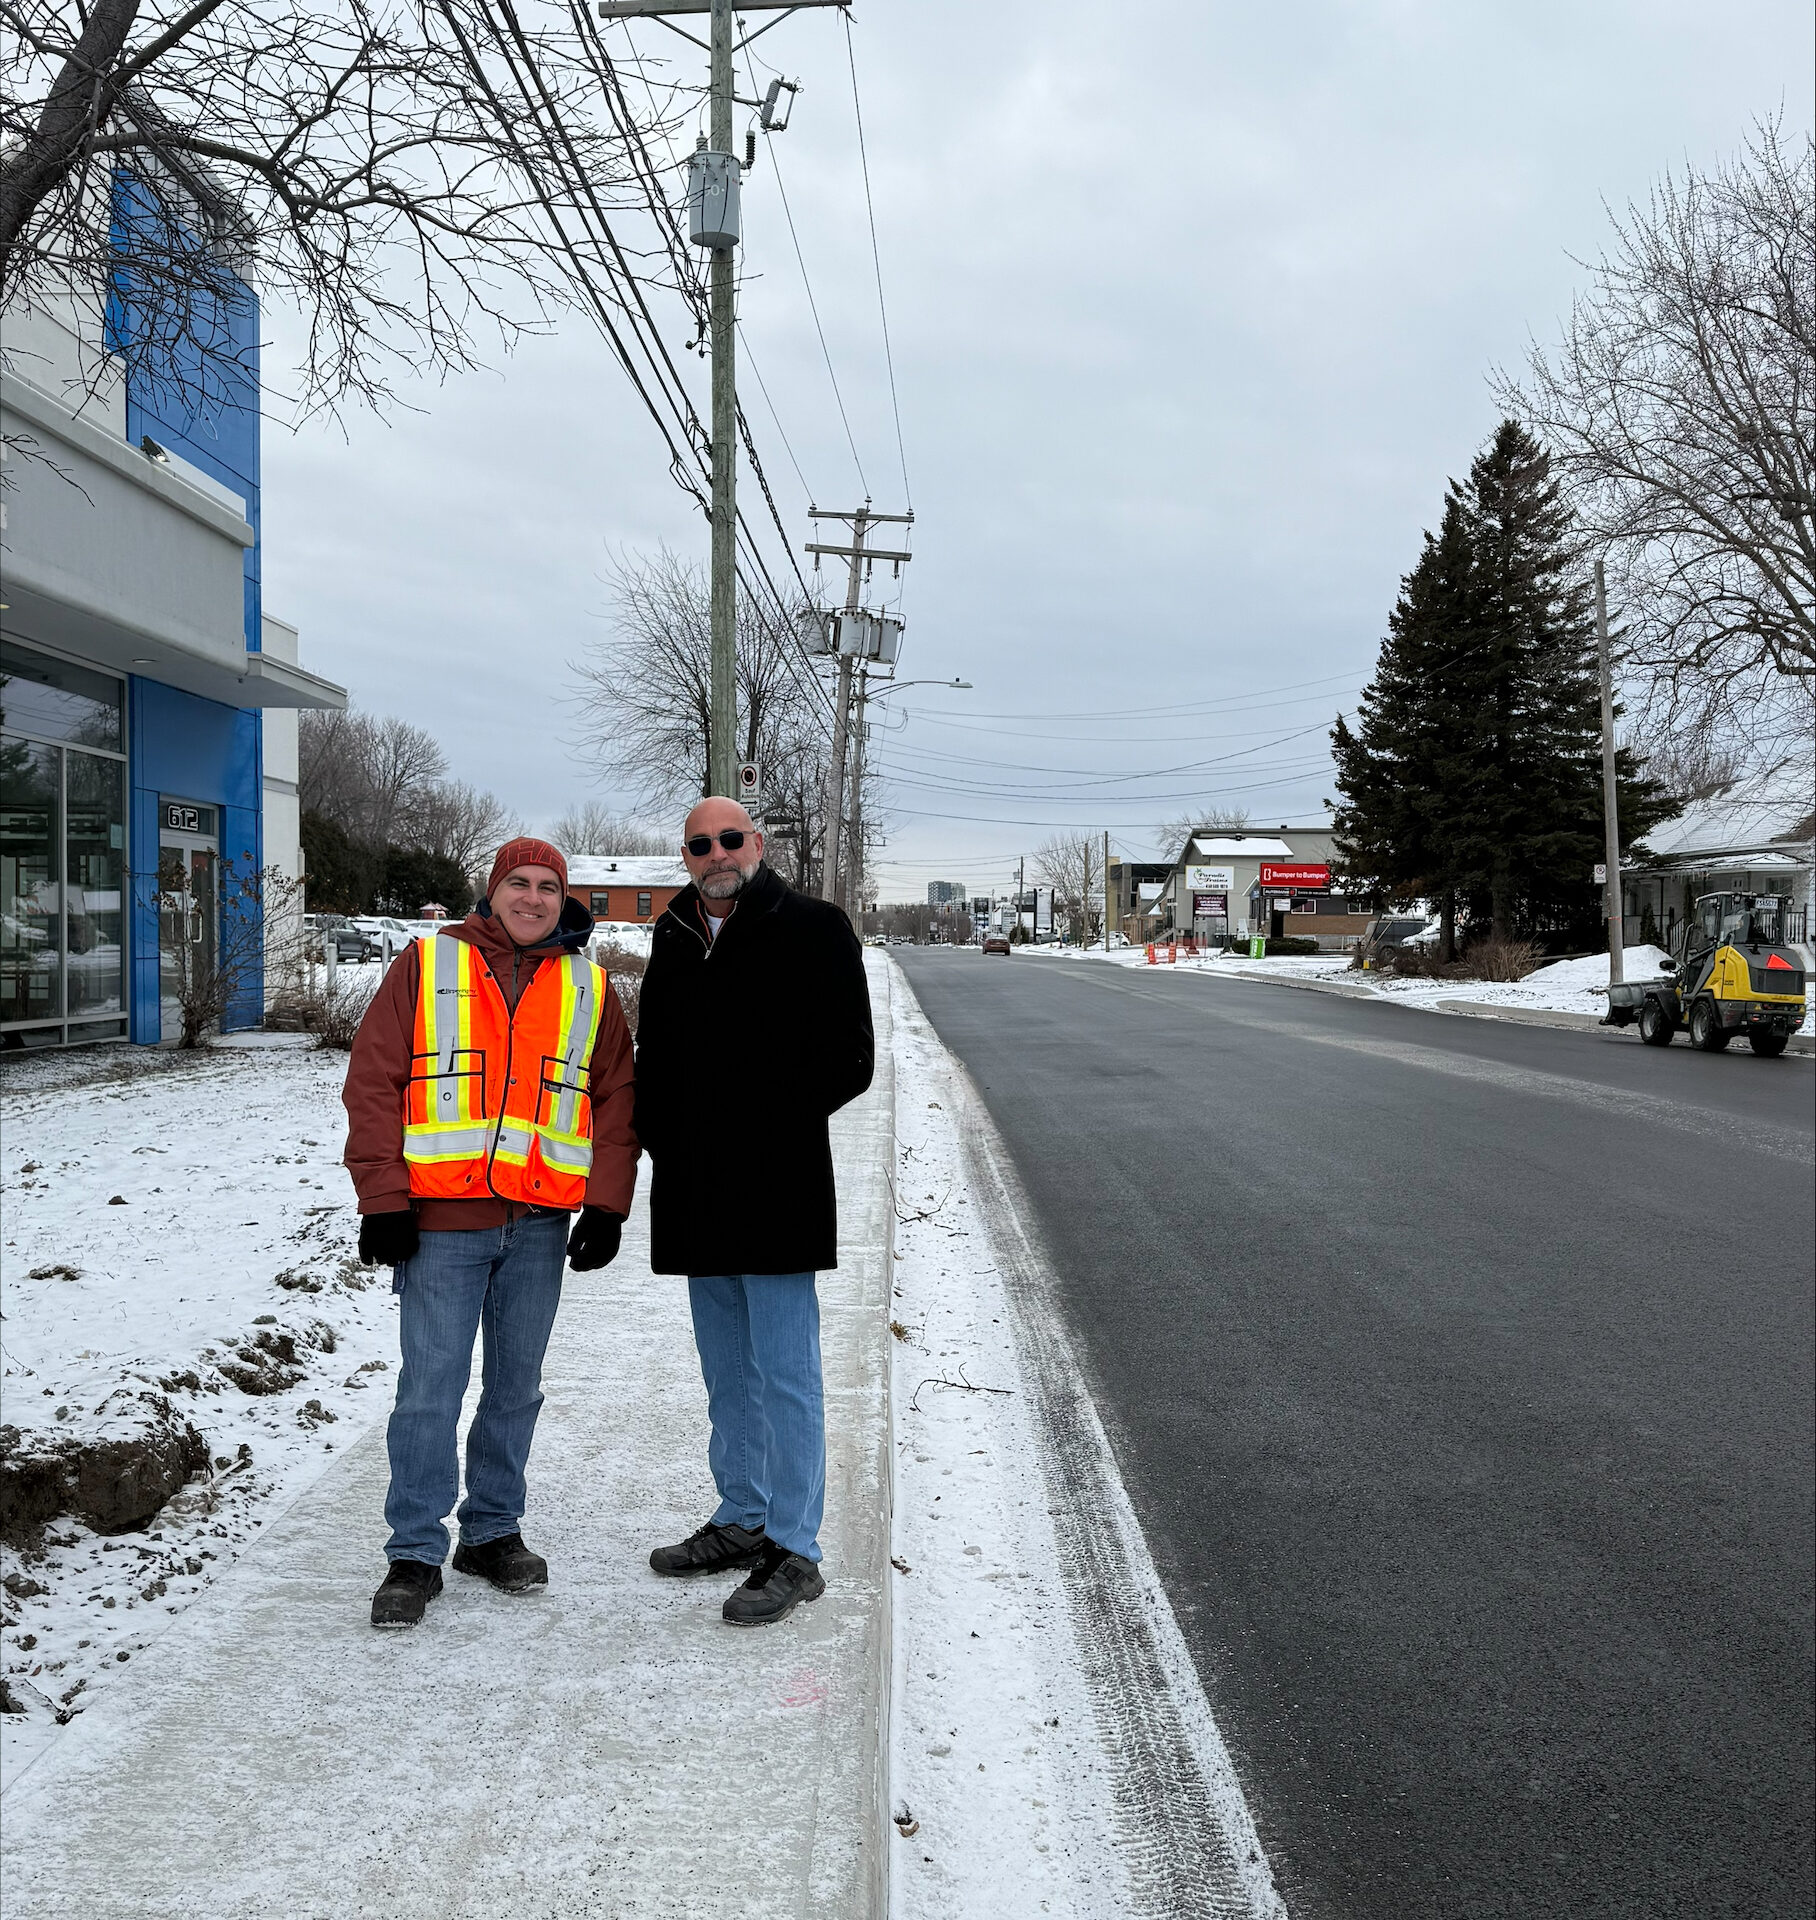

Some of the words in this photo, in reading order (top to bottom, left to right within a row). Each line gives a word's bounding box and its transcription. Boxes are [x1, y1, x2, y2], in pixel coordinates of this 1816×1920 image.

[168, 805, 198, 831] 612
[1273, 871, 1295, 879] Bumper
[1303, 872, 1326, 880] Bumper
